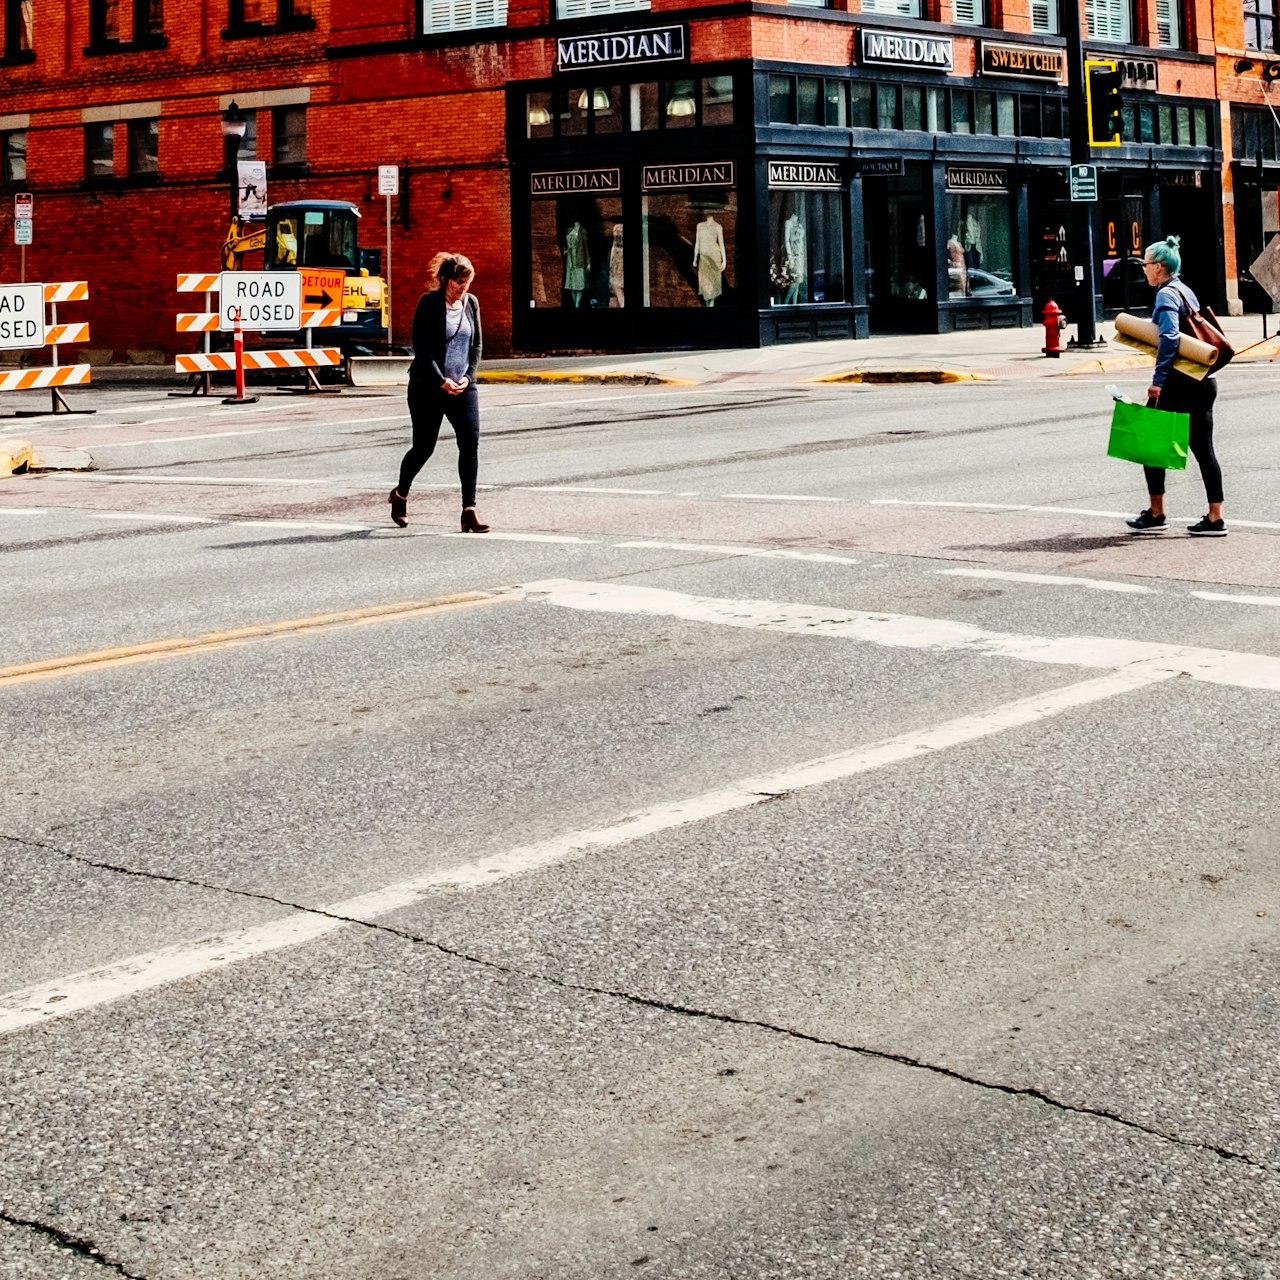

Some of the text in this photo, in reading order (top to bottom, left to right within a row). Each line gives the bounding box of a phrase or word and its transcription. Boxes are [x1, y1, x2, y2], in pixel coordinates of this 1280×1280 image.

[558, 32, 671, 65] MERIDIAN
[868, 35, 952, 64] MERIDIAN
[991, 48, 1031, 70] SWEET
[533, 173, 613, 191] MERIDIAN
[646, 166, 726, 185] MERIDIAN
[771, 166, 836, 182] MERIDIAN
[949, 172, 1003, 186] MERIDIAN
[237, 281, 285, 297] ROAD
[344, 286, 367, 297] EHL
[227, 304, 294, 321] CLOSED
